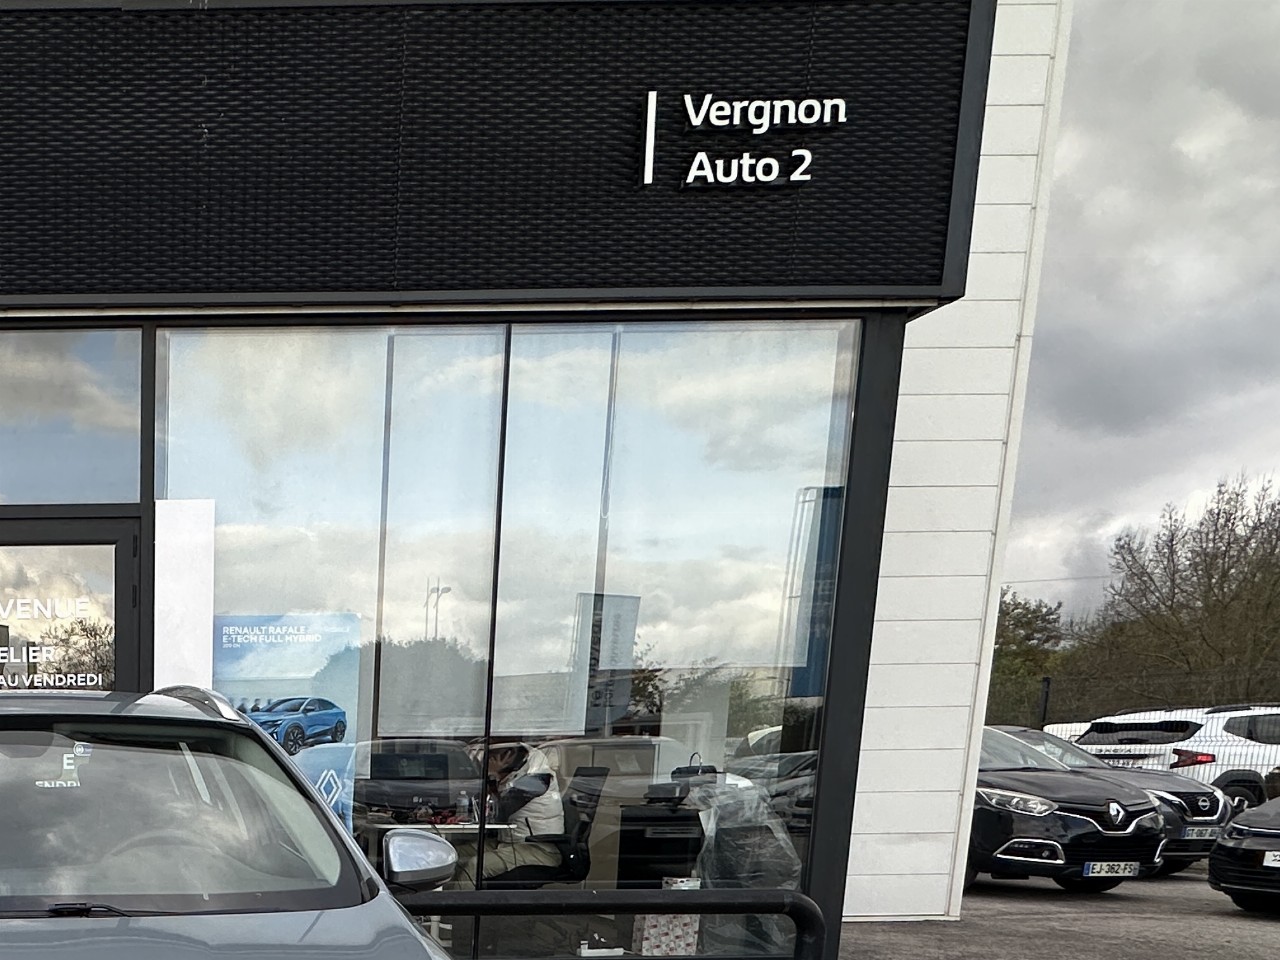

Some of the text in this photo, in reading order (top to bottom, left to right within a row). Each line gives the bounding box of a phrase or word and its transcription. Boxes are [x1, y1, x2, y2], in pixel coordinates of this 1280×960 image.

[683, 94, 847, 134] Vergnon
[686, 149, 813, 183] Auto 2
[223, 626, 306, 634] RENAULT RAFALE
[259, 635, 283, 643] FULL
[286, 634, 322, 643] HYBRID
[22, 674, 102, 687] VENDREDI
[1091, 864, 1133, 874] EJ-362-FS
